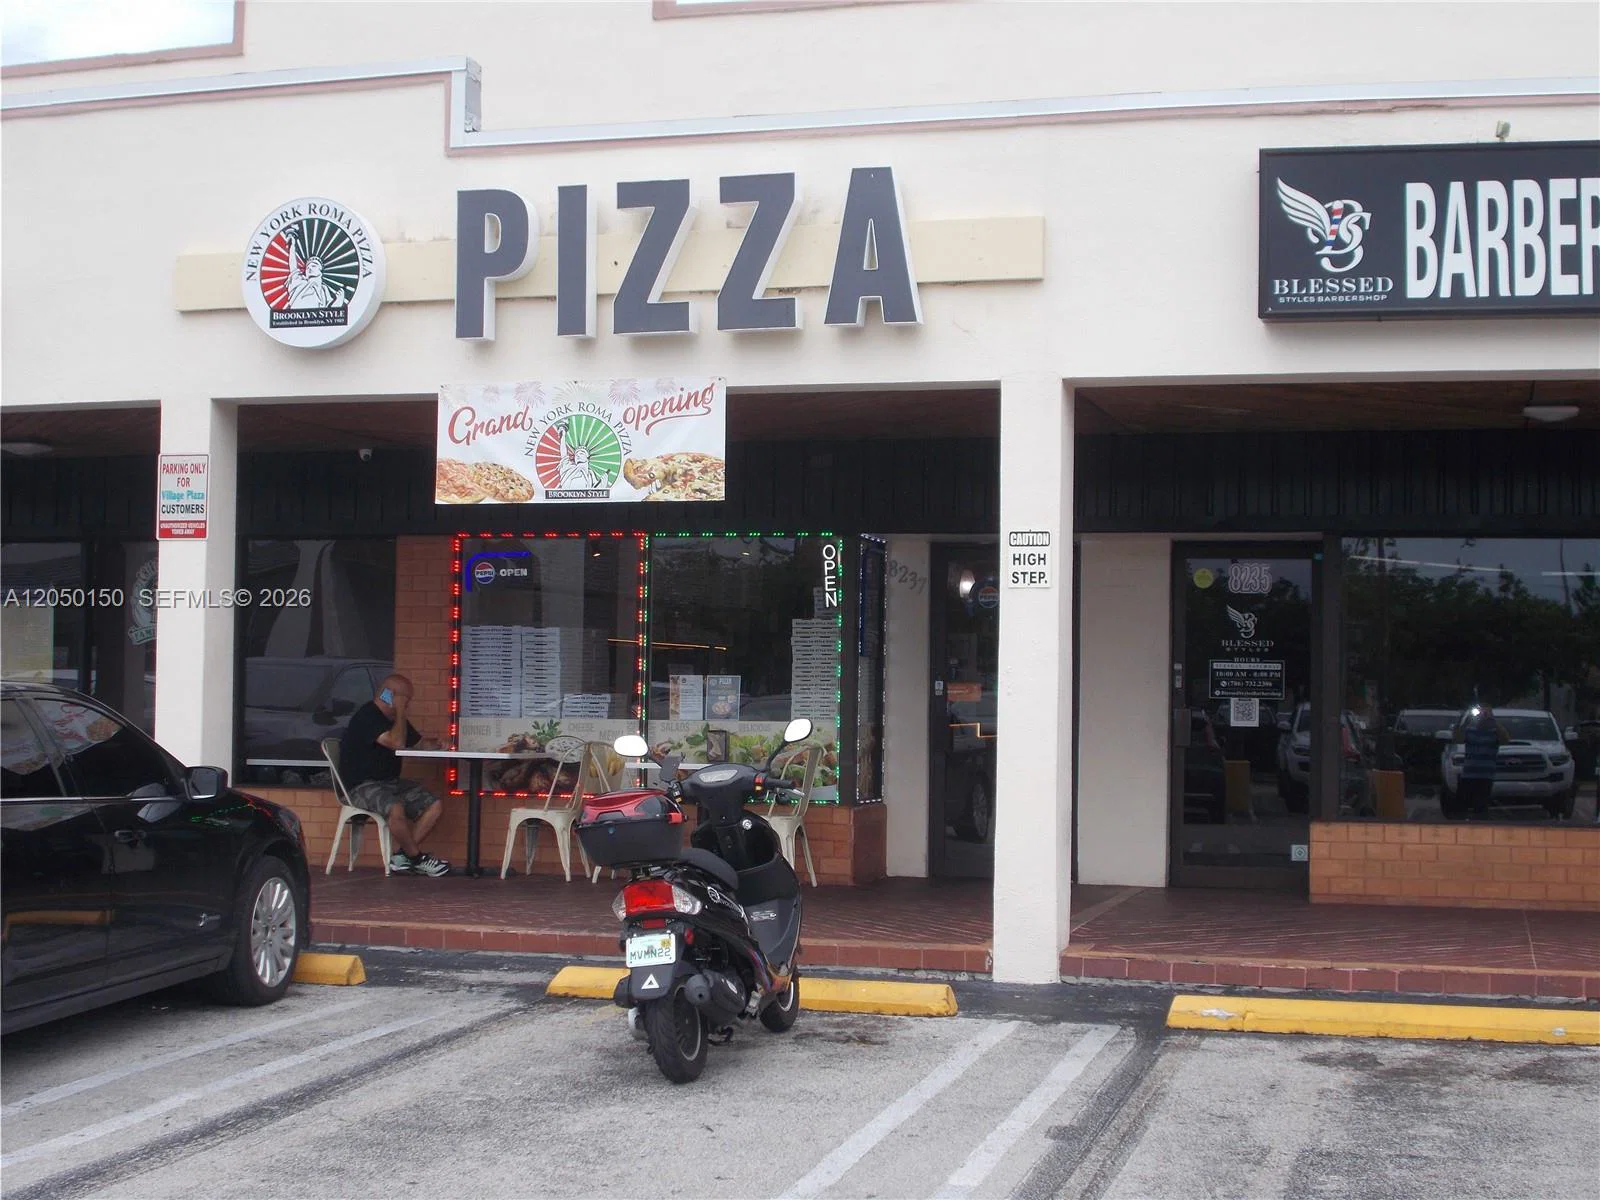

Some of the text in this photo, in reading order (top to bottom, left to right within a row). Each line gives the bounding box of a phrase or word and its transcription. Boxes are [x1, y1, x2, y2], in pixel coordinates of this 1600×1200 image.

[246, 202, 373, 281] NEW YORK ROMA PIZZA
[455, 167, 920, 340] PIZZA
[1273, 276, 1394, 296] BLESSED
[1317, 294, 1388, 302] BARBERSHOP
[273, 310, 345, 320] BROOKLYN STYLE
[623, 382, 716, 436] opening
[448, 405, 534, 446] Grand
[524, 402, 633, 457] NEW YORK ROMA PIZZA
[162, 463, 206, 474] PARKING ONLY
[177, 478, 191, 487] FOR
[161, 490, 205, 502] Village Plaza
[548, 489, 608, 499] BROOKLYN STYLE
[161, 504, 205, 514] CUSTOMERS
[1010, 533, 1049, 546] CAUTION
[1012, 553, 1046, 565] HIGH
[499, 568, 527, 577] OPEN
[822, 544, 838, 608] OPEN
[888, 559, 928, 596] 8237
[1012, 571, 1047, 584] STEP.
[1228, 563, 1272, 593] 8235
[1221, 639, 1275, 647] BLESSED
[629, 946, 671, 961] MVMN22
